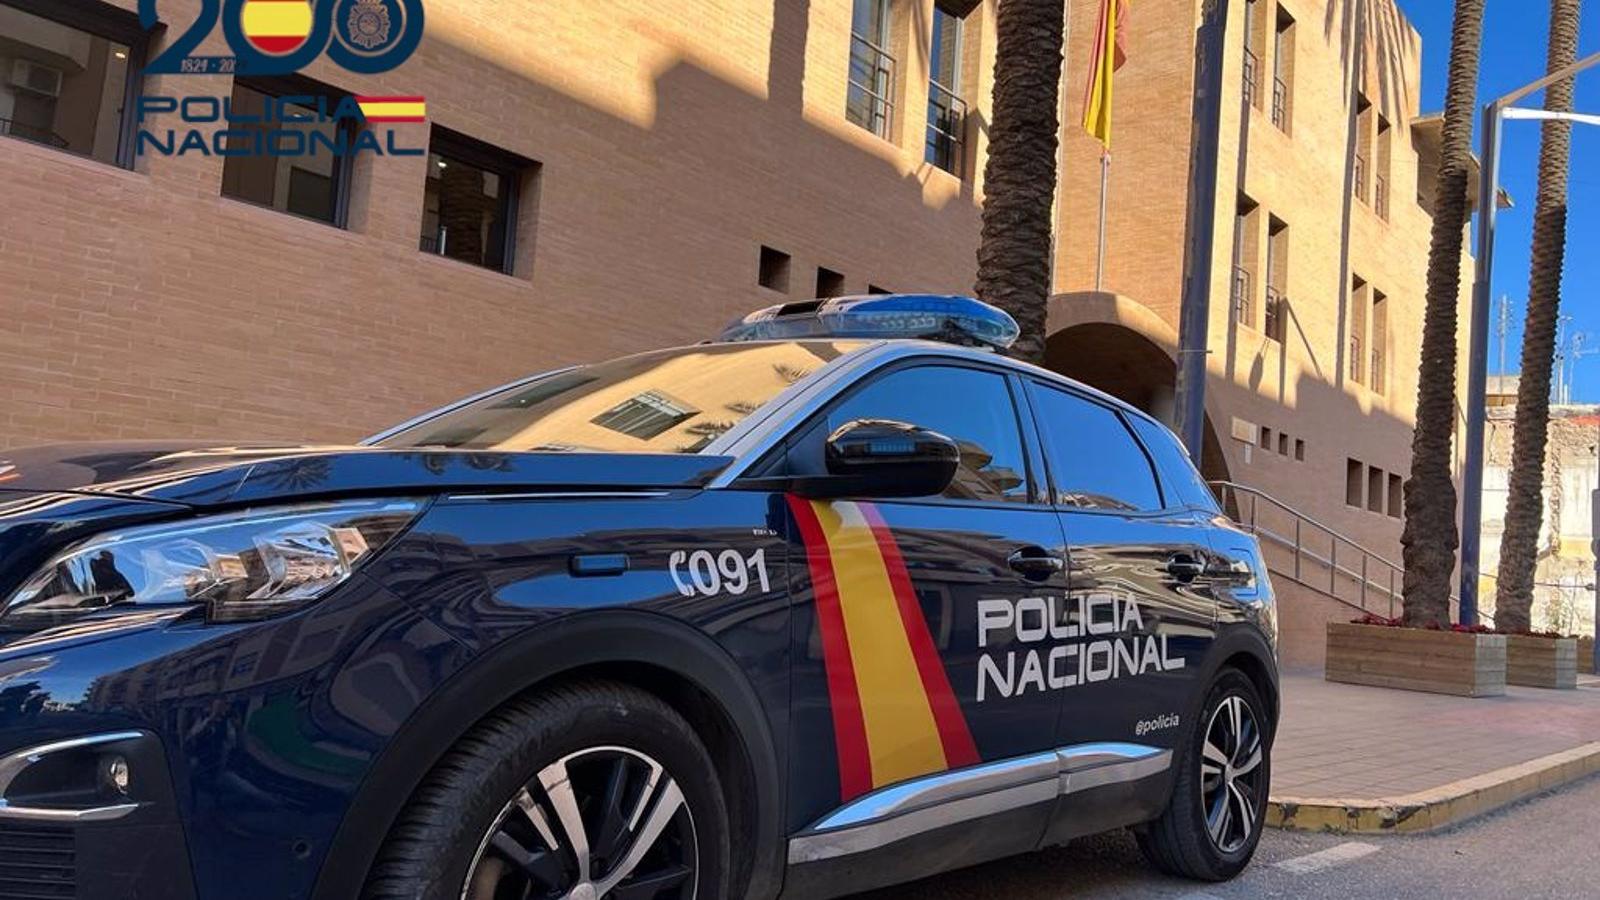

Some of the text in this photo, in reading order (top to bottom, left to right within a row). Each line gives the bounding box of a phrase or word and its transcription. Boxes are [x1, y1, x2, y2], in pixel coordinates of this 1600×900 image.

[688, 549, 769, 596] 091
[977, 593, 1144, 647] POLICIA
[977, 634, 1185, 702] NACIONAL
